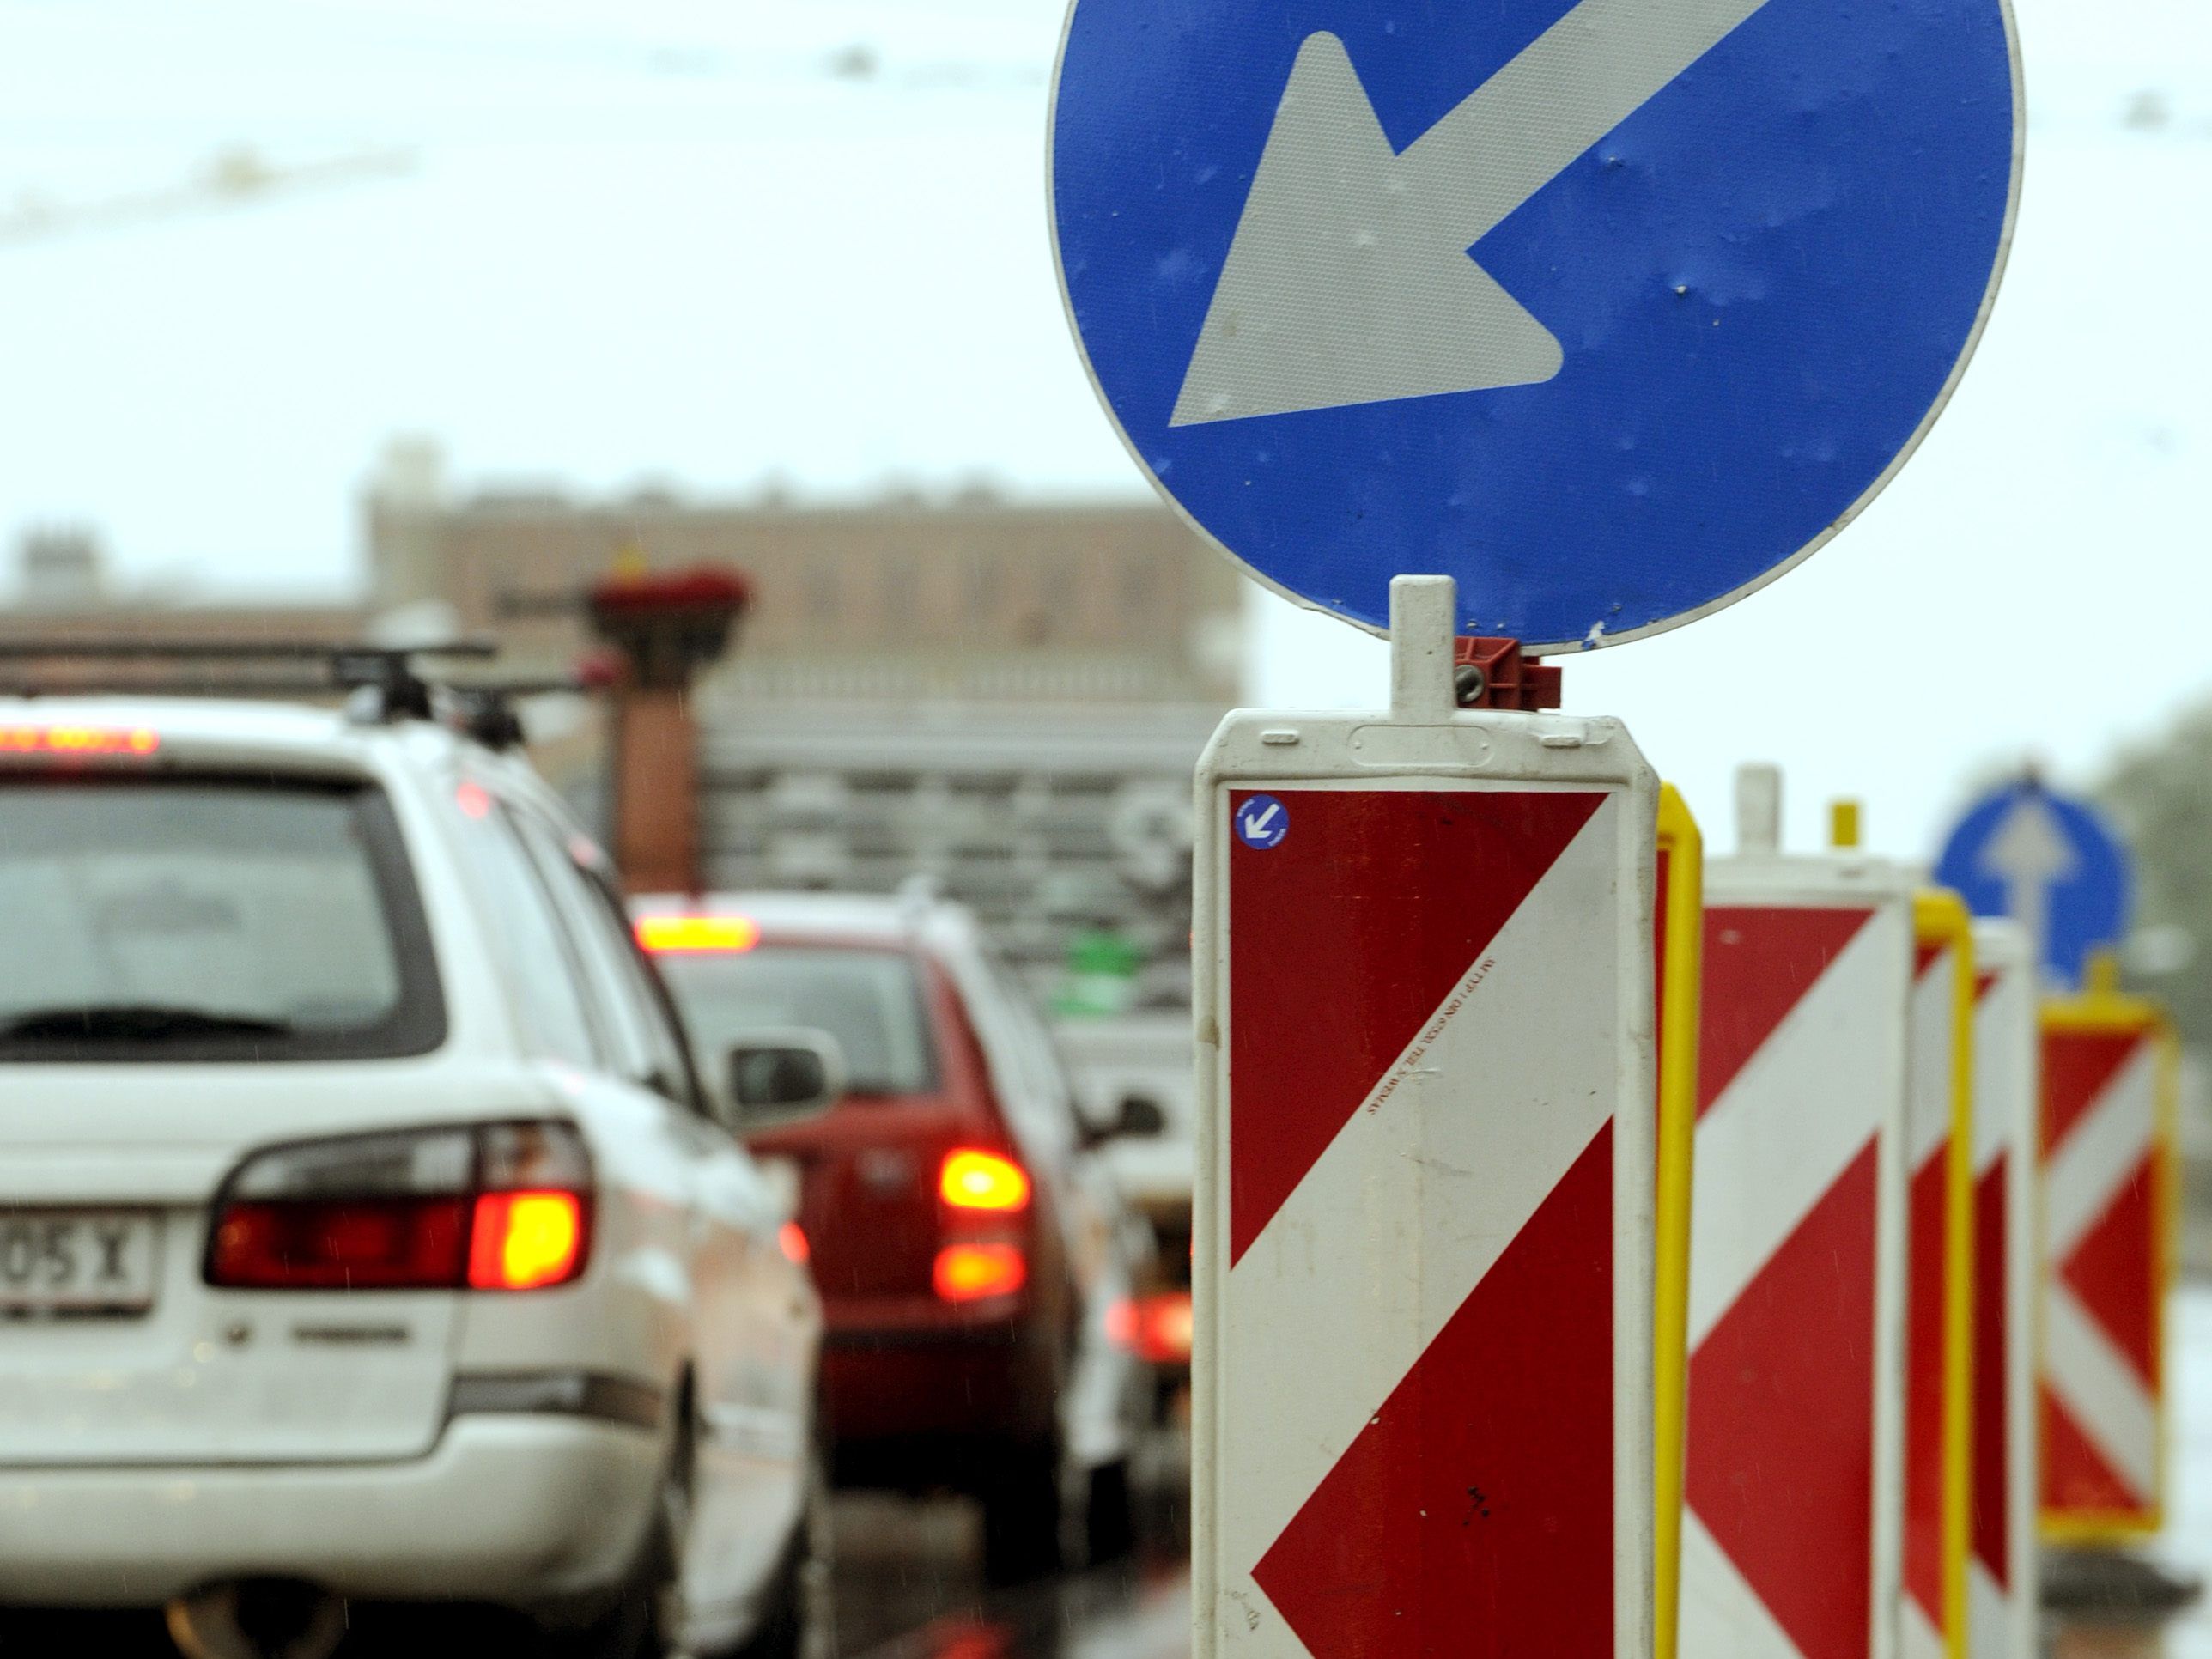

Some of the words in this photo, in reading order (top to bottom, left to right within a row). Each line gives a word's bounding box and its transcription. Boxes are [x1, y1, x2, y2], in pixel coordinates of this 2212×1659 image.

[1465, 972, 1483, 993] TYP
[1444, 999, 1462, 1018] DIN
[1367, 1078, 1399, 1115] WEMAS
